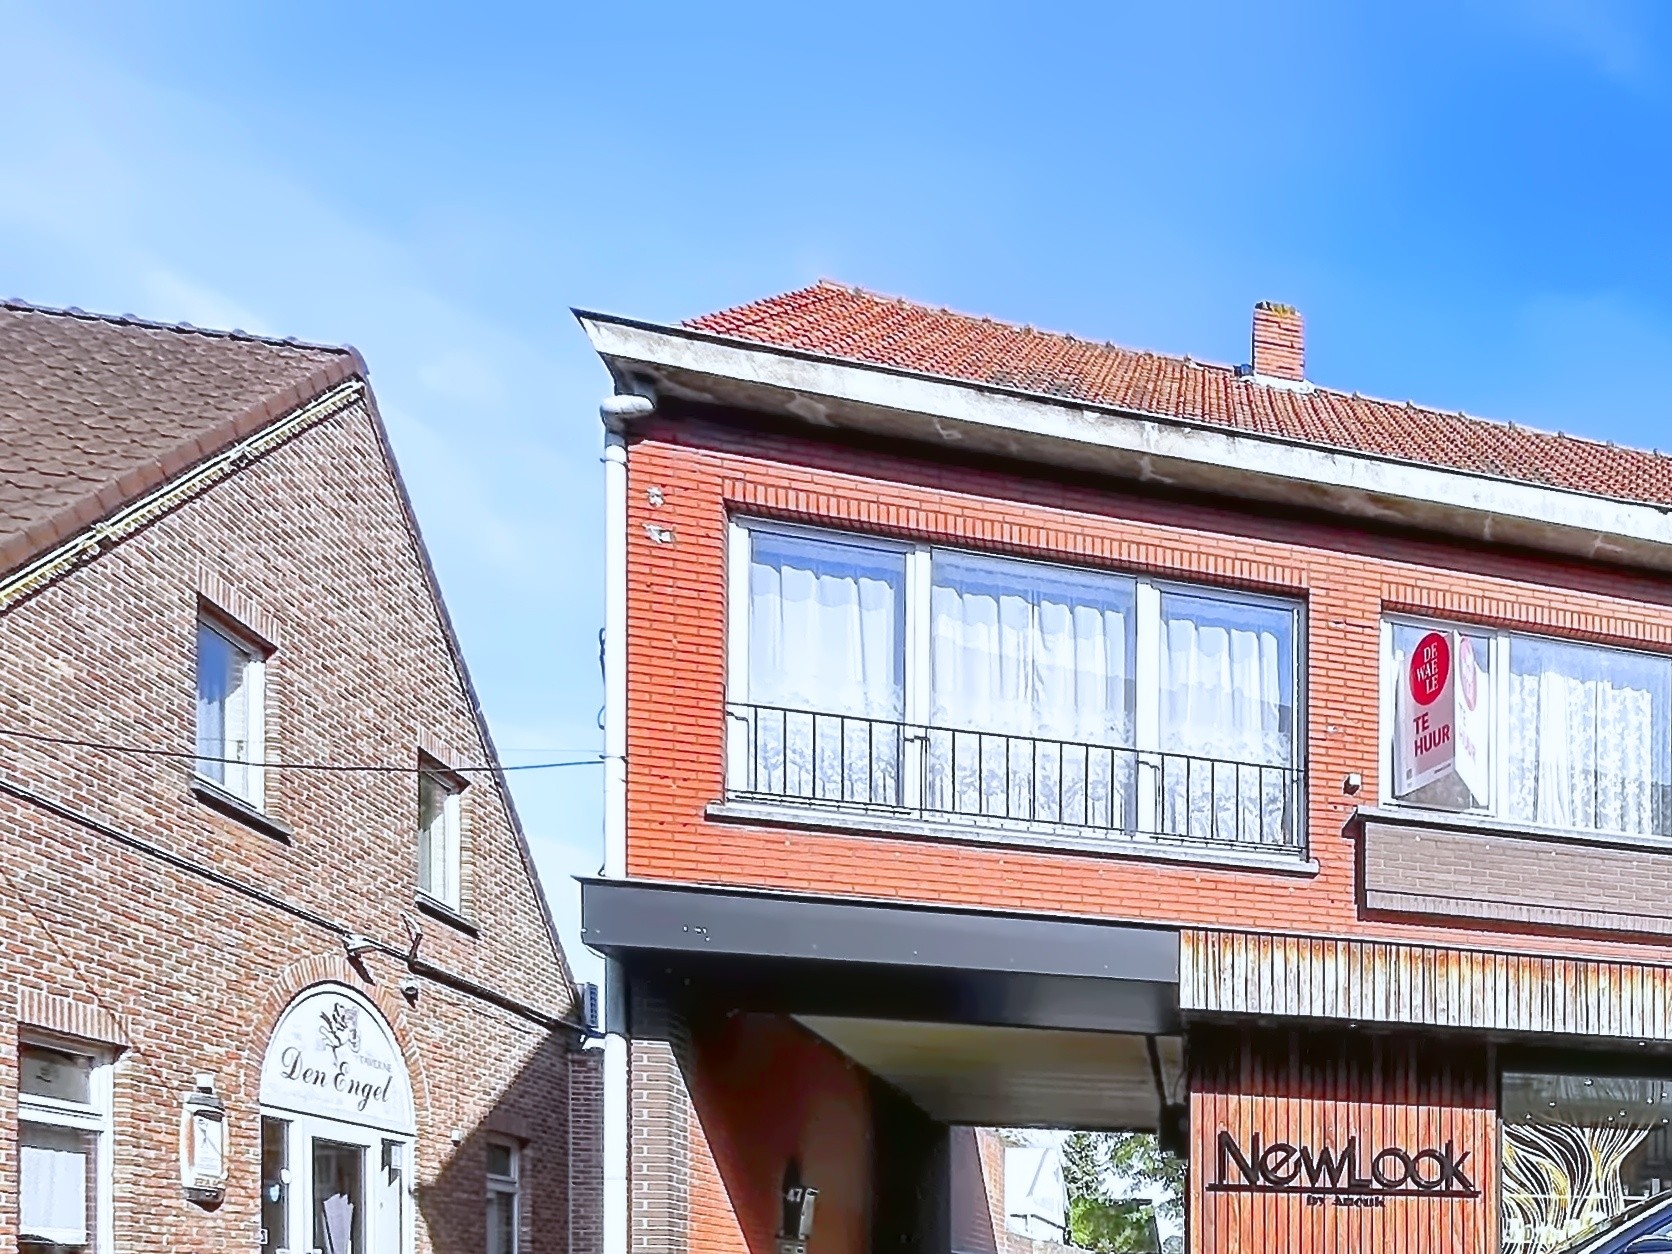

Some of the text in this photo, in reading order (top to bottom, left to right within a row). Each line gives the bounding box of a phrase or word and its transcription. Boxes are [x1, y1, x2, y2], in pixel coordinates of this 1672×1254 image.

[1423, 641, 1438, 662] DE
[1416, 660, 1439, 682] WAE
[1426, 675, 1439, 694] LE
[1413, 712, 1430, 735] TE
[1414, 724, 1451, 757] HUUR
[281, 1046, 393, 1112] Den Engel
[1218, 1130, 1475, 1191] NewLook
[787, 1188, 803, 1202] 47
